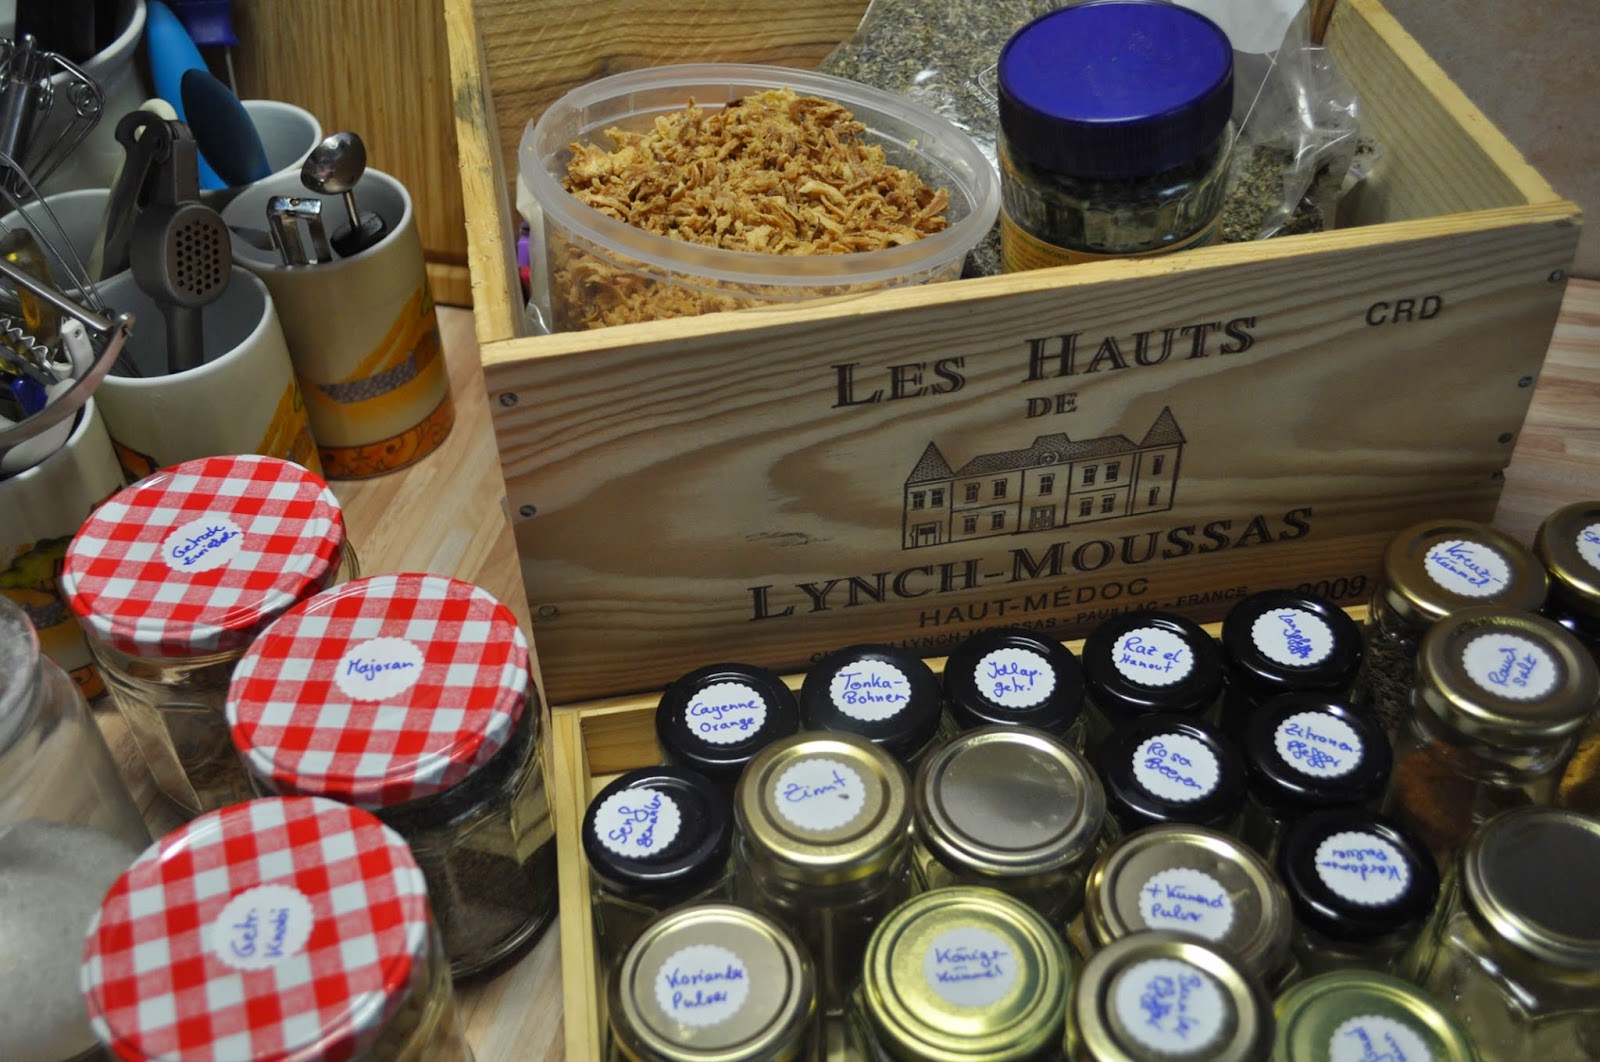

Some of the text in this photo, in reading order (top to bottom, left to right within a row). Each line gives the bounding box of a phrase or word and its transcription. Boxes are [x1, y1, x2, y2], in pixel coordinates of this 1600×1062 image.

[1365, 294, 1445, 326] CRD
[831, 316, 1257, 409] LES HAUTS
[1026, 392, 1077, 420] DE
[748, 507, 1313, 621] LYNCH-MOUSSAS
[919, 578, 1149, 628] HAUT-MÉDOC
[1177, 586, 1250, 607] FRANCE
[1119, 653, 1174, 674] Hanout
[1163, 648, 1182, 663] el
[346, 658, 415, 681] Majoran
[689, 697, 760, 720] Cayenne
[841, 689, 907, 705] Bohnen
[699, 715, 756, 734] Orange
[1146, 741, 1192, 767] Rosa
[1143, 757, 1202, 790] Beeren
